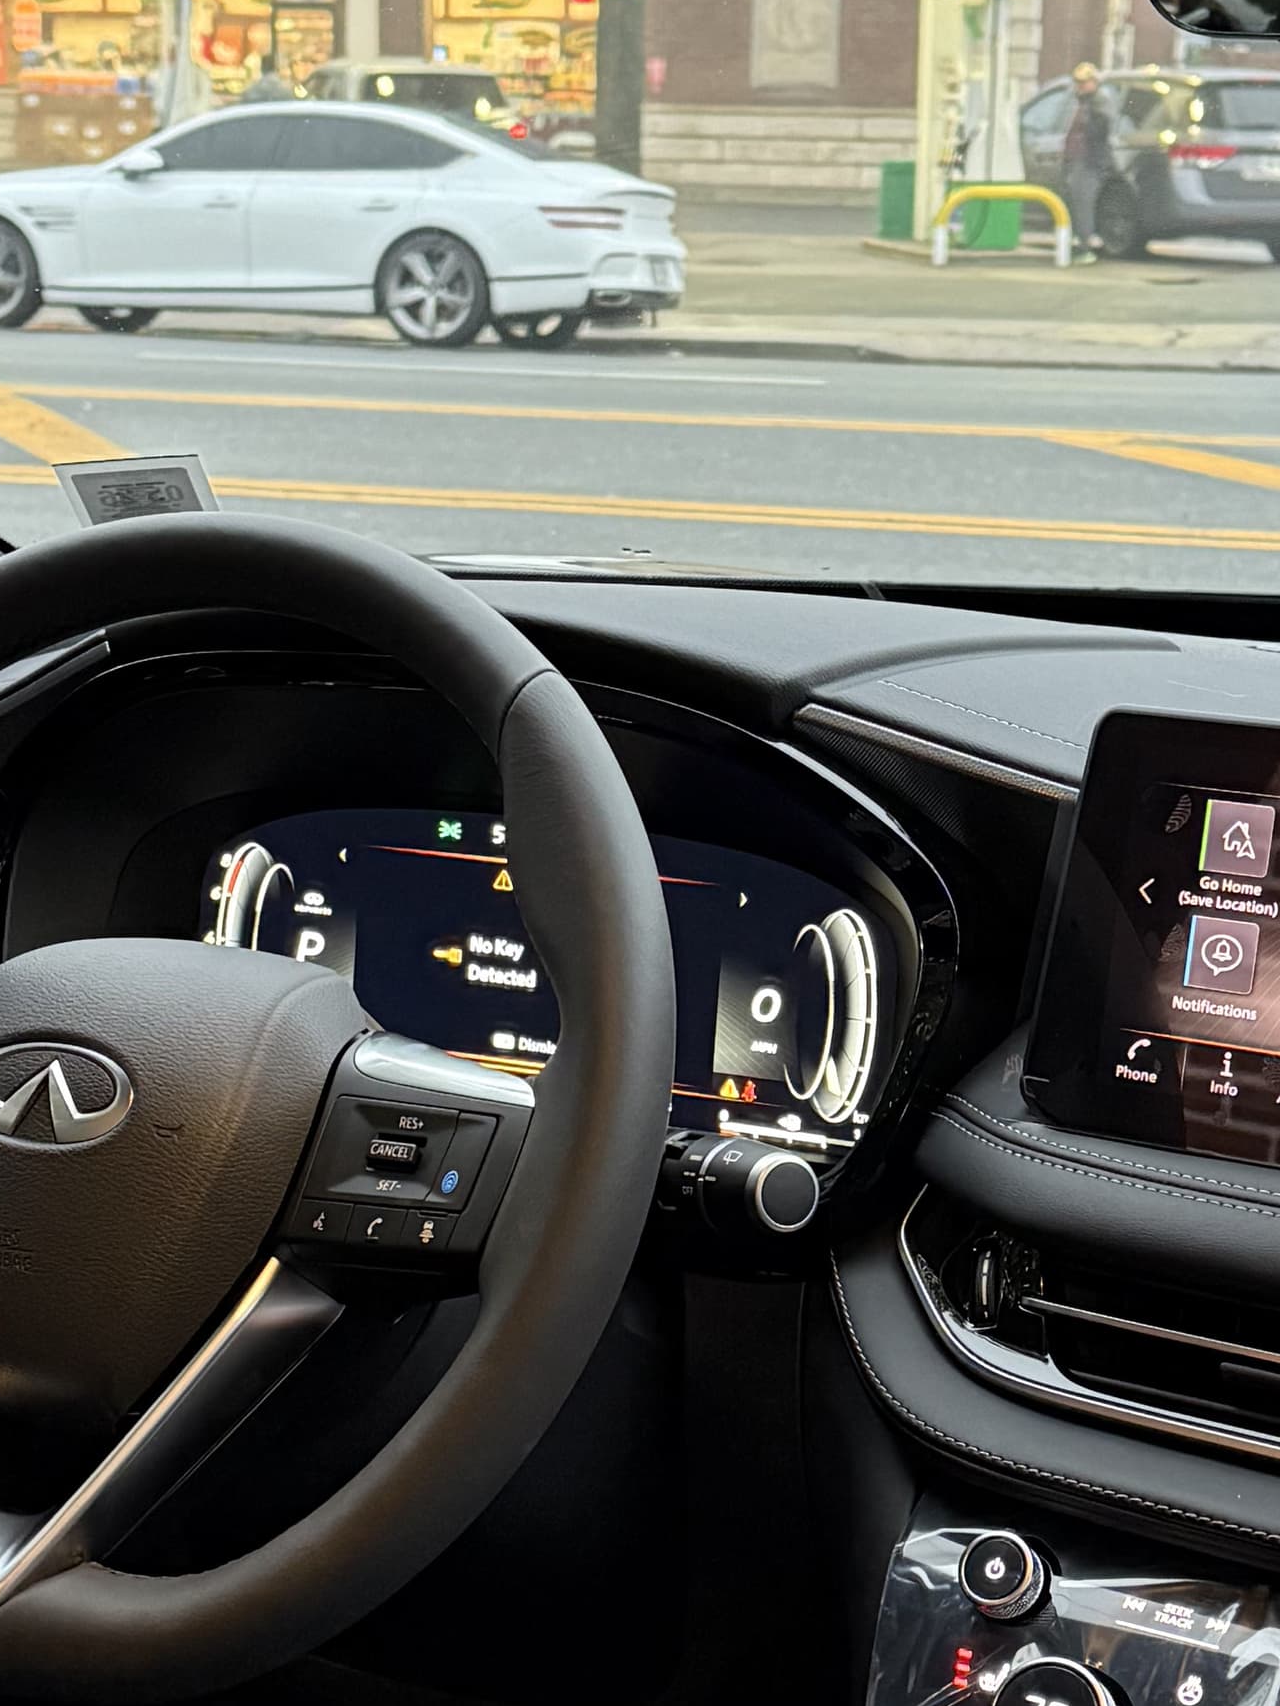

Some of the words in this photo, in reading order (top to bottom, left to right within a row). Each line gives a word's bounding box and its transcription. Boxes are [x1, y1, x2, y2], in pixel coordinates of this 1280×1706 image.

[1199, 875, 1219, 891] Go
[1221, 878, 1263, 897] Home
[1178, 890, 1214, 909] (Save
[1216, 894, 1279, 919] Location)
[296, 930, 326, 962] P
[469, 935, 493, 955] No
[494, 938, 524, 962] Key
[467, 963, 538, 989] Detected
[751, 988, 781, 1023] 0
[1171, 995, 1257, 1021] Notifications
[518, 1036, 557, 1055] Dismis
[1115, 1064, 1158, 1084] Phone
[1209, 1080, 1239, 1097] Info
[399, 1116, 425, 1130] RES+
[369, 1142, 410, 1159] CANCEL
[1154, 1610, 1195, 1632] TRACK
[1164, 1602, 1194, 1619] SEEK
